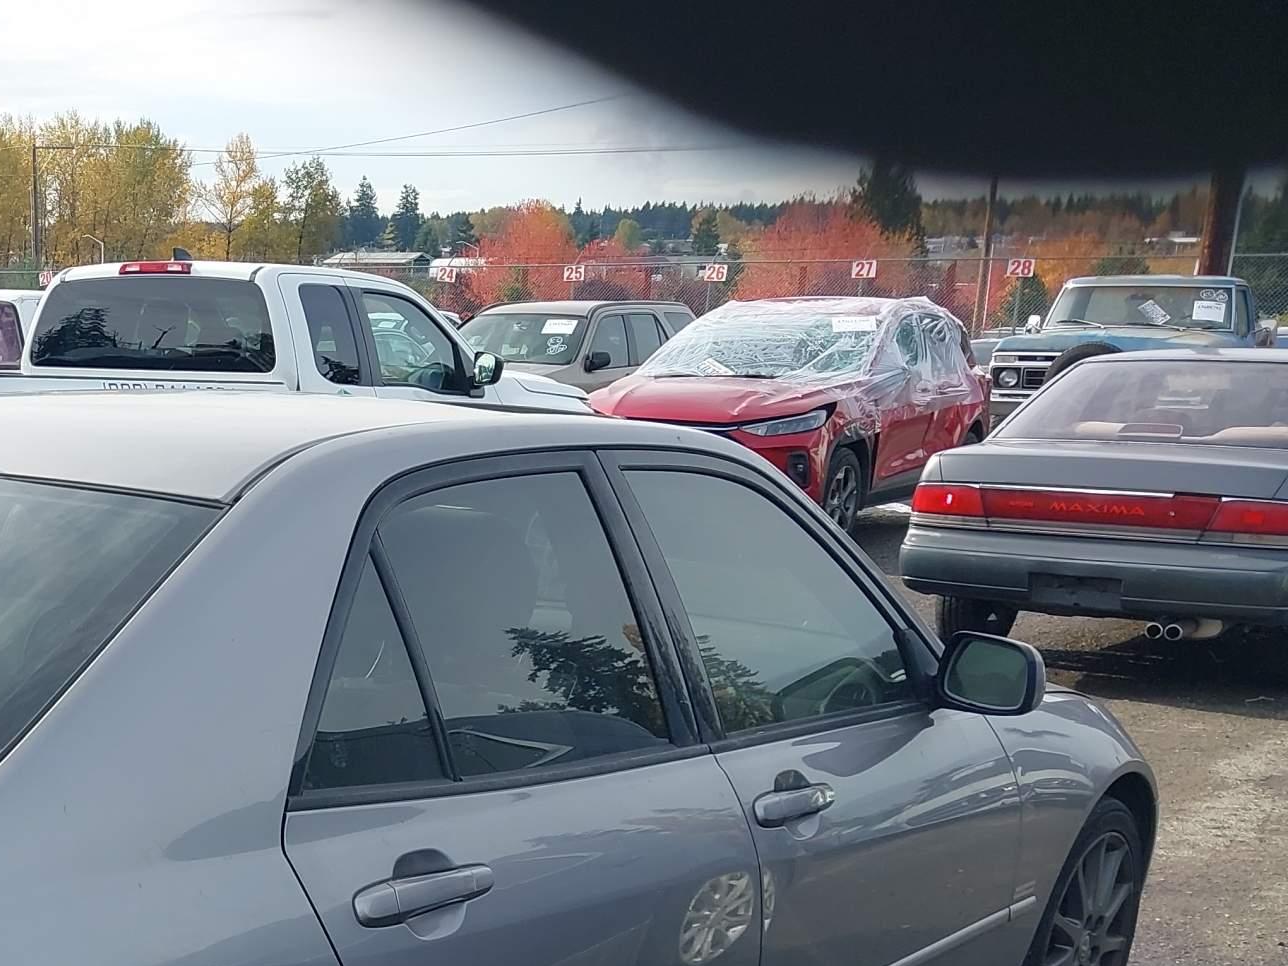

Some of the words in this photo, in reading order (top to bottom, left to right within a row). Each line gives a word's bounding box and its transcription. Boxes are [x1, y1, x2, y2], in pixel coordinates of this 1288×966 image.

[439, 268, 454, 281] 24
[566, 267, 582, 280] 25
[707, 266, 724, 280] 26
[855, 261, 874, 277] 27
[1010, 260, 1032, 276] 28
[40, 272, 52, 285] 20
[1049, 501, 1145, 516] MAXIMA
